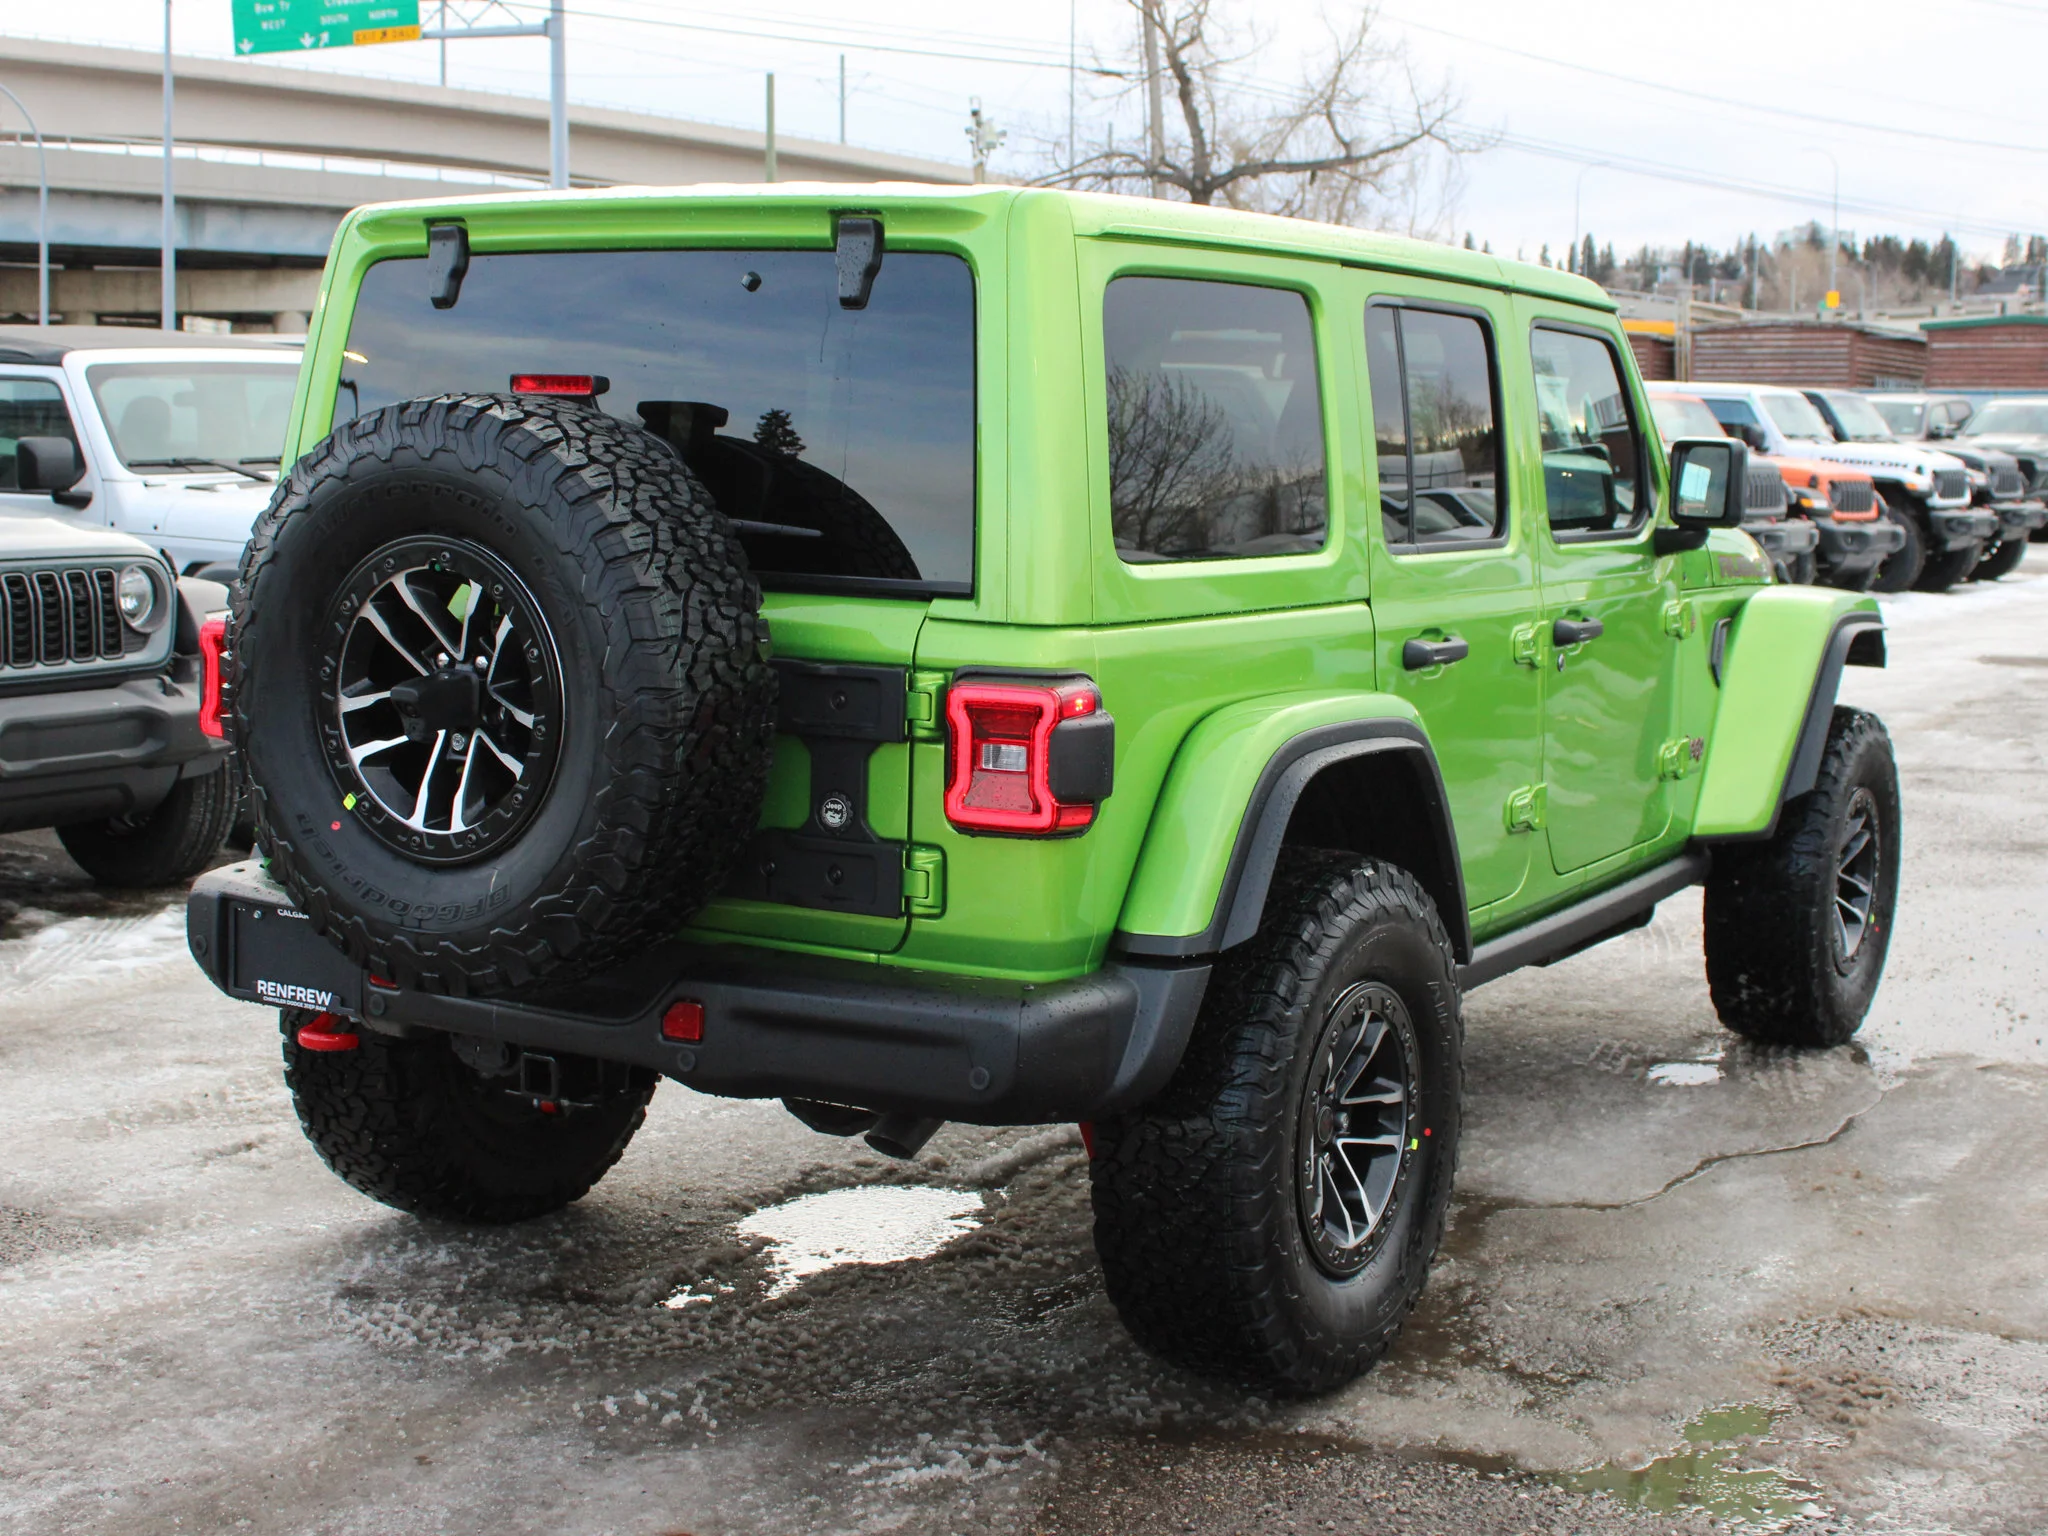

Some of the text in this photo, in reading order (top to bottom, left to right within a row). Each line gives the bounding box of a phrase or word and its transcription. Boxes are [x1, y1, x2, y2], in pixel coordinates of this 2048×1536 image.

[254, 1, 290, 14] Bow Tr
[320, 13, 349, 26] SOUTH
[369, 9, 398, 20] NORTH
[261, 19, 286, 30] WEST
[355, 27, 417, 42] EXIT ONLY
[826, 802, 842, 810] Jeep
[257, 980, 332, 1006] RENFREW
